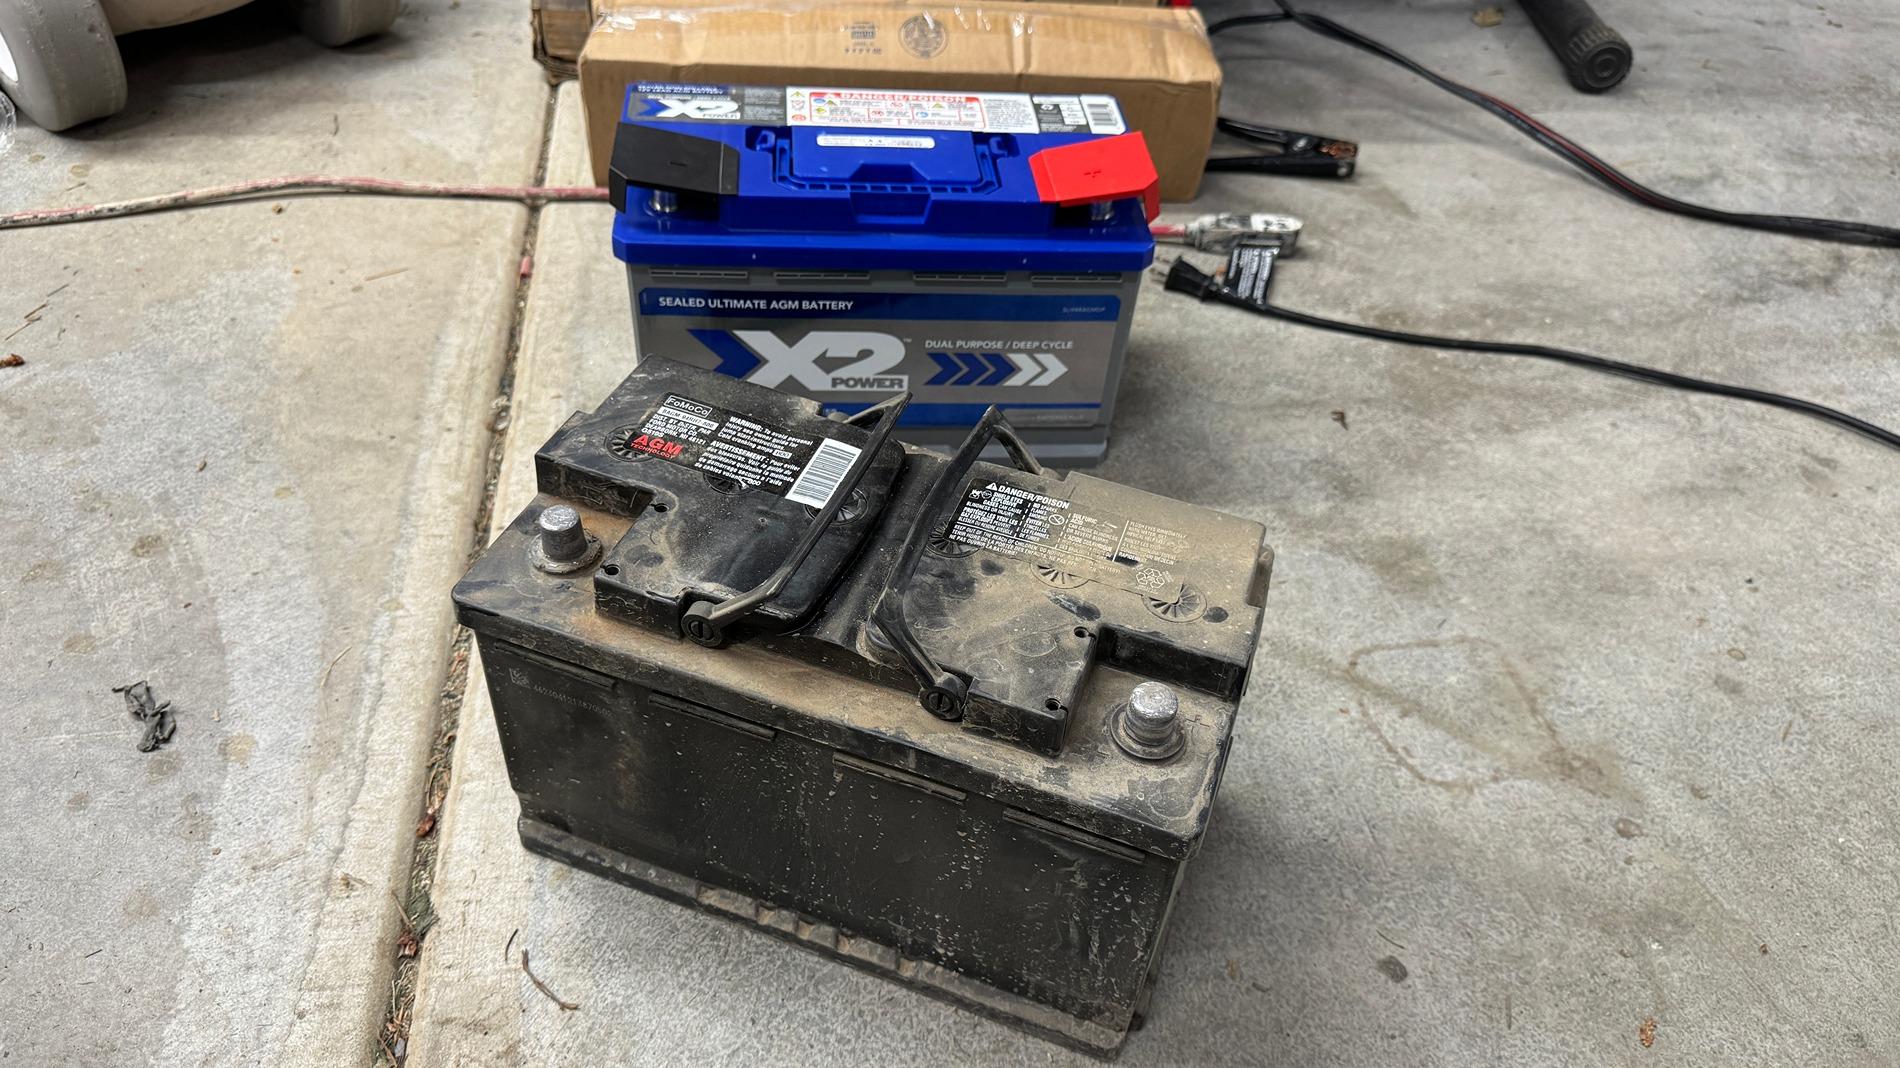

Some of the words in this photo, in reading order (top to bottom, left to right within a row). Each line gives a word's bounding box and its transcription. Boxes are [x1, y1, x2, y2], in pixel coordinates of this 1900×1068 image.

[658, 296, 705, 308] SEALED
[708, 298, 768, 310] ULTIMATE
[770, 300, 799, 310] AGM
[801, 300, 854, 311] BATTERY
[925, 340, 953, 349] DUAL
[956, 340, 1003, 349] PURPOSE
[1013, 341, 1041, 350] DEEP
[1042, 341, 1073, 350] CYCLE
[732, 330, 907, 391] X2
[831, 377, 904, 390] POWER
[667, 398, 710, 415] FoMoCo
[649, 419, 666, 427] FORD
[666, 424, 688, 434] MOTOR
[721, 428, 737, 436] jump
[729, 417, 764, 432] WARNING:
[772, 430, 789, 439] avoid
[788, 435, 813, 447] personal
[725, 423, 743, 432] injury
[753, 432, 773, 441] owner
[772, 437, 790, 446] guide
[634, 433, 684, 455] AGM
[717, 432, 732, 440] Cold
[731, 437, 757, 448] cranking
[757, 445, 774, 453] amps
[631, 443, 676, 459] TECHNOLOGY
[710, 441, 767, 462] AVERTISSEMENT
[770, 459, 784, 467] Pour
[737, 469, 761, 480] secours
[767, 465, 785, 474] guide
[991, 497, 1017, 508] EXPLOSIVE
[993, 492, 1010, 501] SHIELD
[998, 485, 1070, 509] DANGER/POISON
[967, 501, 991, 511] BLINDNESS
[998, 510, 1014, 518] INJURY
[983, 500, 998, 508] GASES
[1008, 507, 1022, 515] CAUSE
[1072, 513, 1098, 524] SULFURIC
